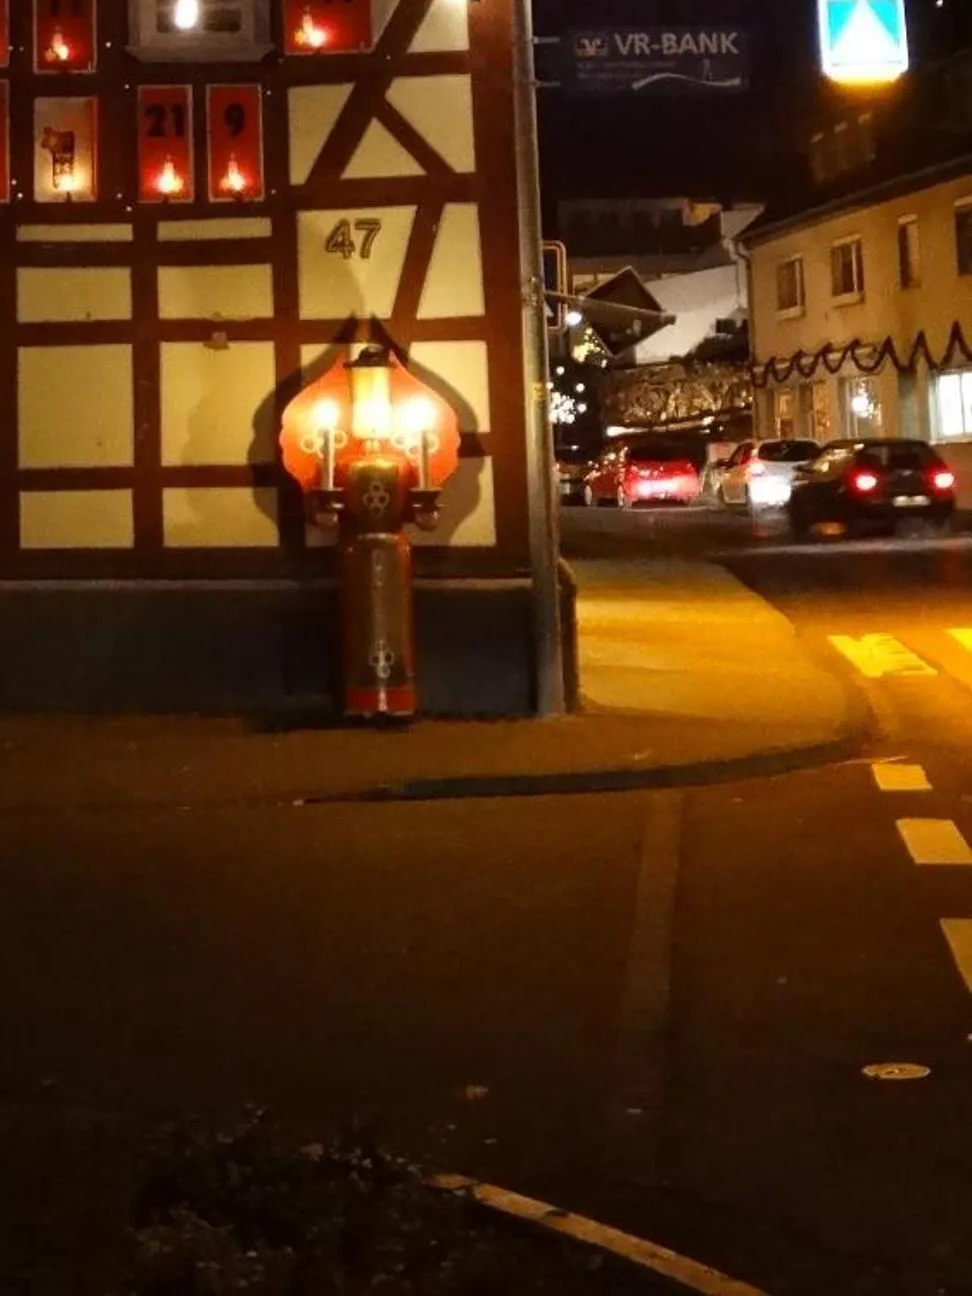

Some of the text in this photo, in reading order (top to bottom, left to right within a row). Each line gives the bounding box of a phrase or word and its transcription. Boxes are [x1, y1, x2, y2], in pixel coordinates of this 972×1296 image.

[613, 31, 740, 56] VR-BANK
[144, 103, 186, 137] 21
[224, 103, 246, 137] 9
[325, 217, 382, 260] 47
